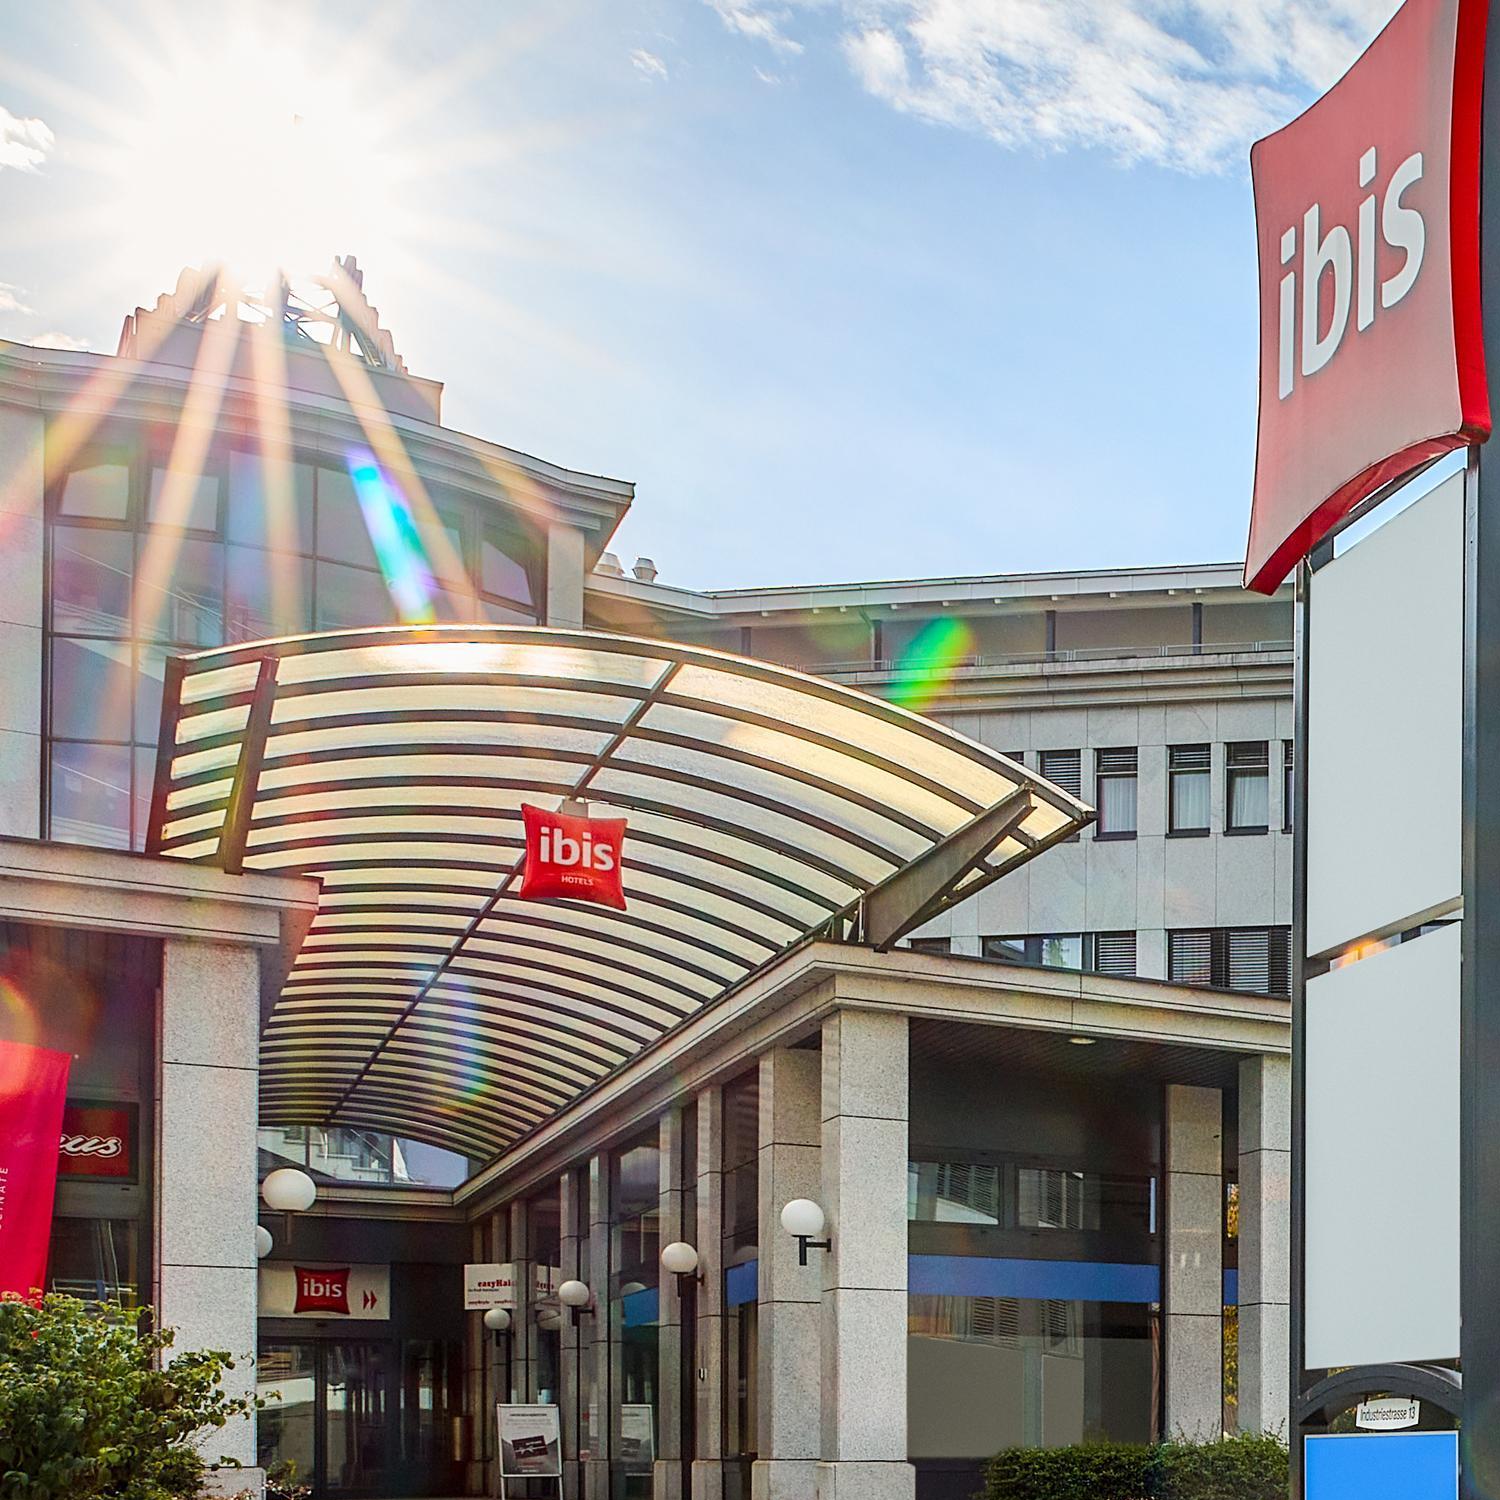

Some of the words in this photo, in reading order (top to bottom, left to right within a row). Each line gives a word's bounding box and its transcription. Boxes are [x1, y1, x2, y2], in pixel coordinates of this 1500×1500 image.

[1278, 146, 1426, 401] ibis
[540, 826, 615, 872] ibis
[561, 875, 594, 886] HOTELS
[303, 1278, 342, 1298] ibis
[1361, 1408, 1407, 1421] Industriestrasse
[1408, 1406, 1415, 1420] 13
